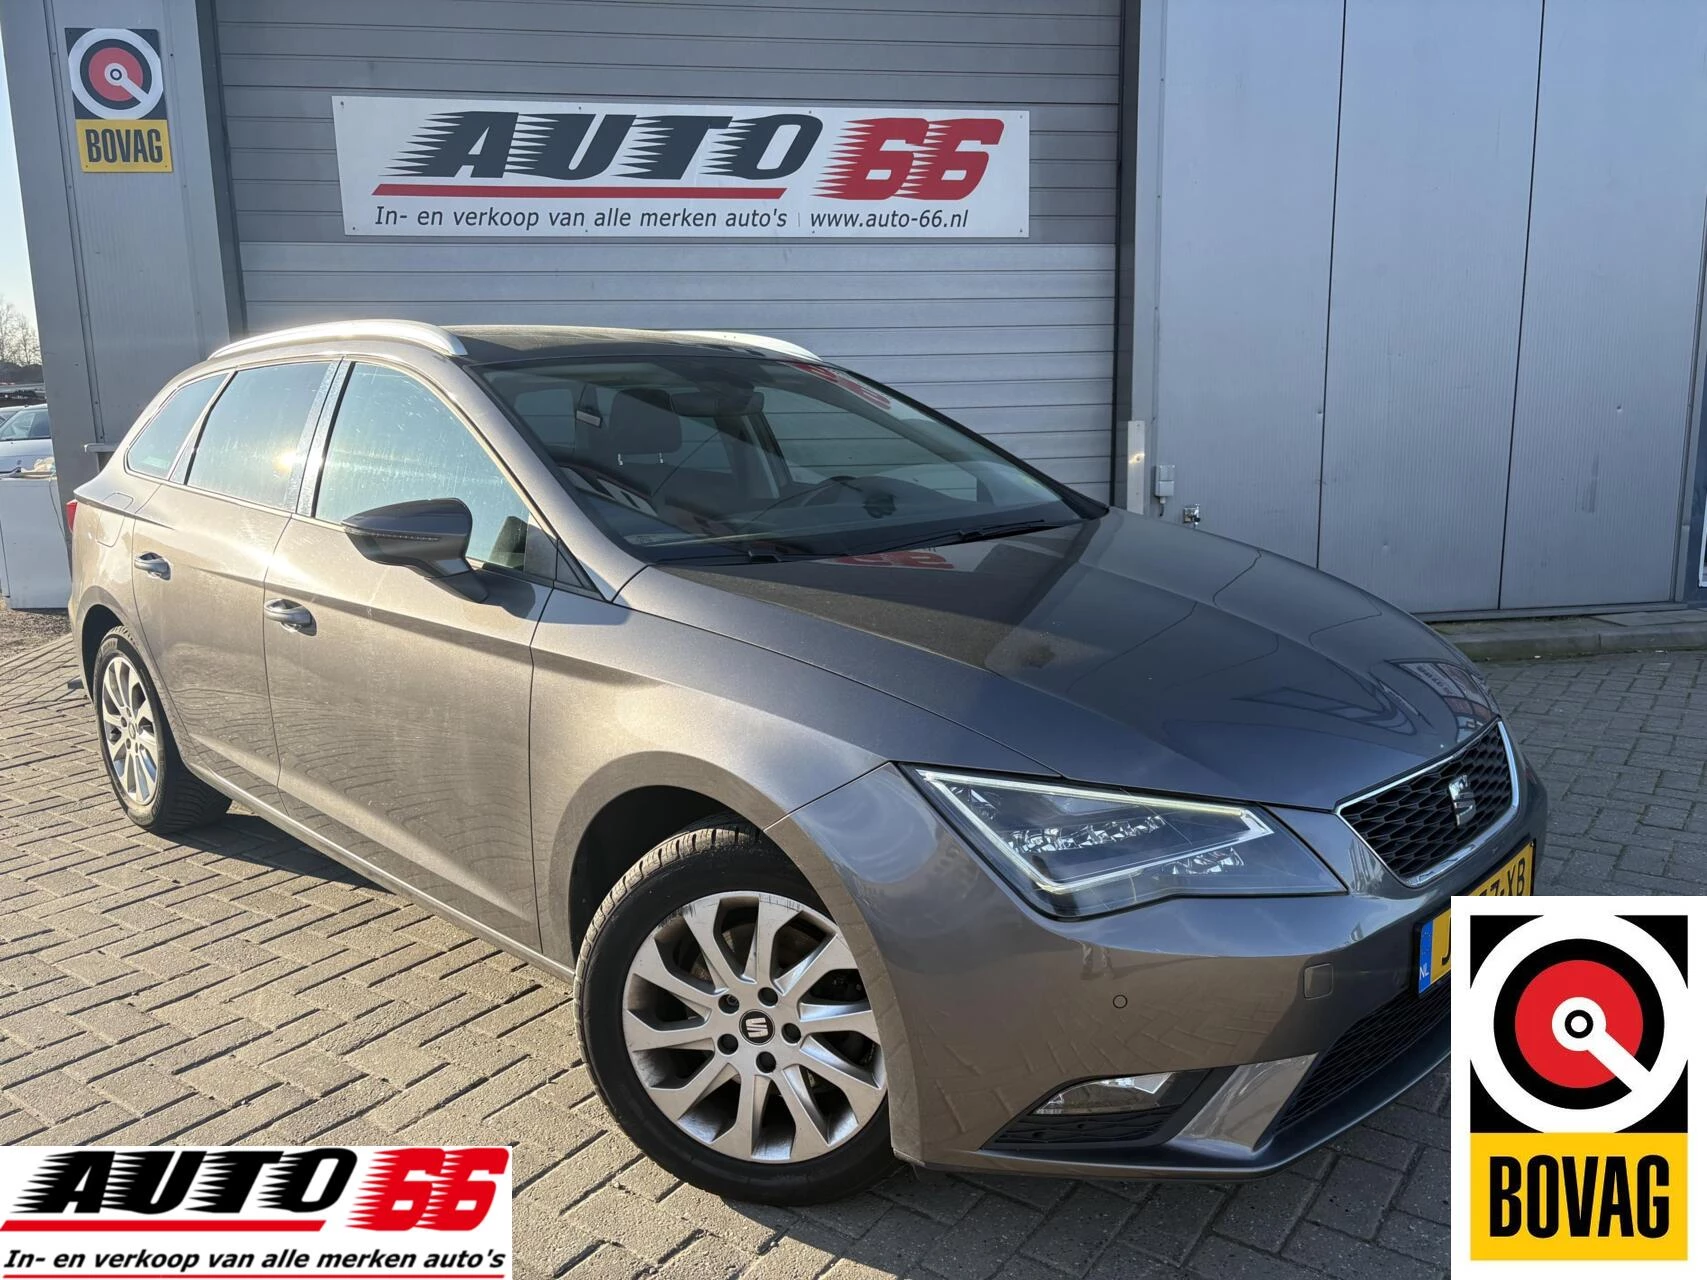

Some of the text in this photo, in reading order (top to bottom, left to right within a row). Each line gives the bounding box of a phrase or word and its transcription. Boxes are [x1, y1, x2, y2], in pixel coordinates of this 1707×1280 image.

[85, 128, 163, 164] BOVAG
[378, 110, 1004, 201] AUTO 66
[375, 206, 968, 230] In- en verkoop van alle merken auto's www.auto-66.nl
